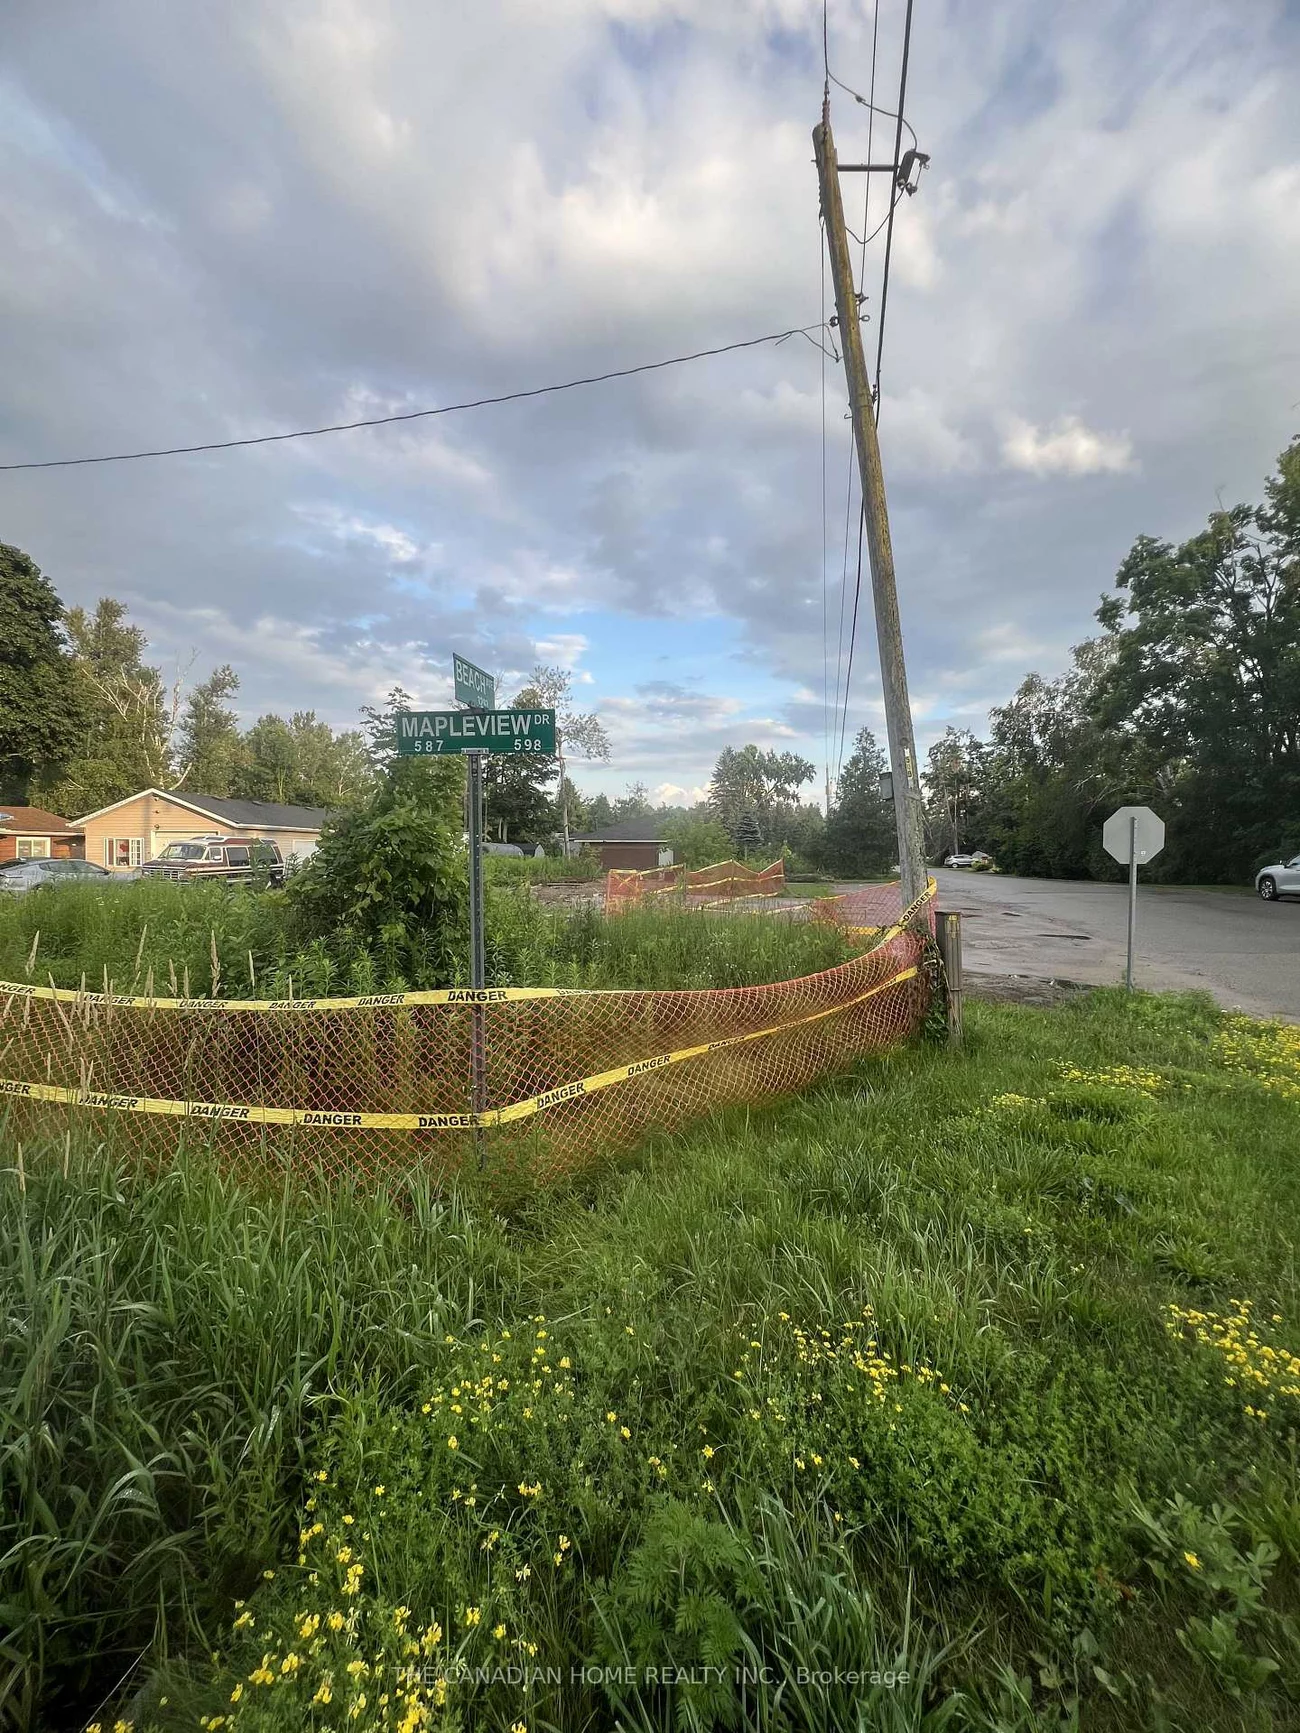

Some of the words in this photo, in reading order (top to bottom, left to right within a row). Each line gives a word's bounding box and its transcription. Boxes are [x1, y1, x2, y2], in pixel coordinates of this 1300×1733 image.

[456, 660, 487, 695] BEACH
[402, 714, 531, 738] MAPLEVIEW
[534, 714, 550, 725] DR
[414, 740, 444, 752] 587
[514, 739, 542, 751] 598
[902, 891, 931, 921] DANGER
[357, 994, 405, 1006] DANGER
[447, 990, 508, 1002] DANGER
[190, 1105, 250, 1119] DANGER
[303, 1113, 362, 1126] DANGER
[418, 1114, 480, 1128] DANGER
[538, 1081, 585, 1109] DANGER
[627, 1054, 671, 1076] DANGER
